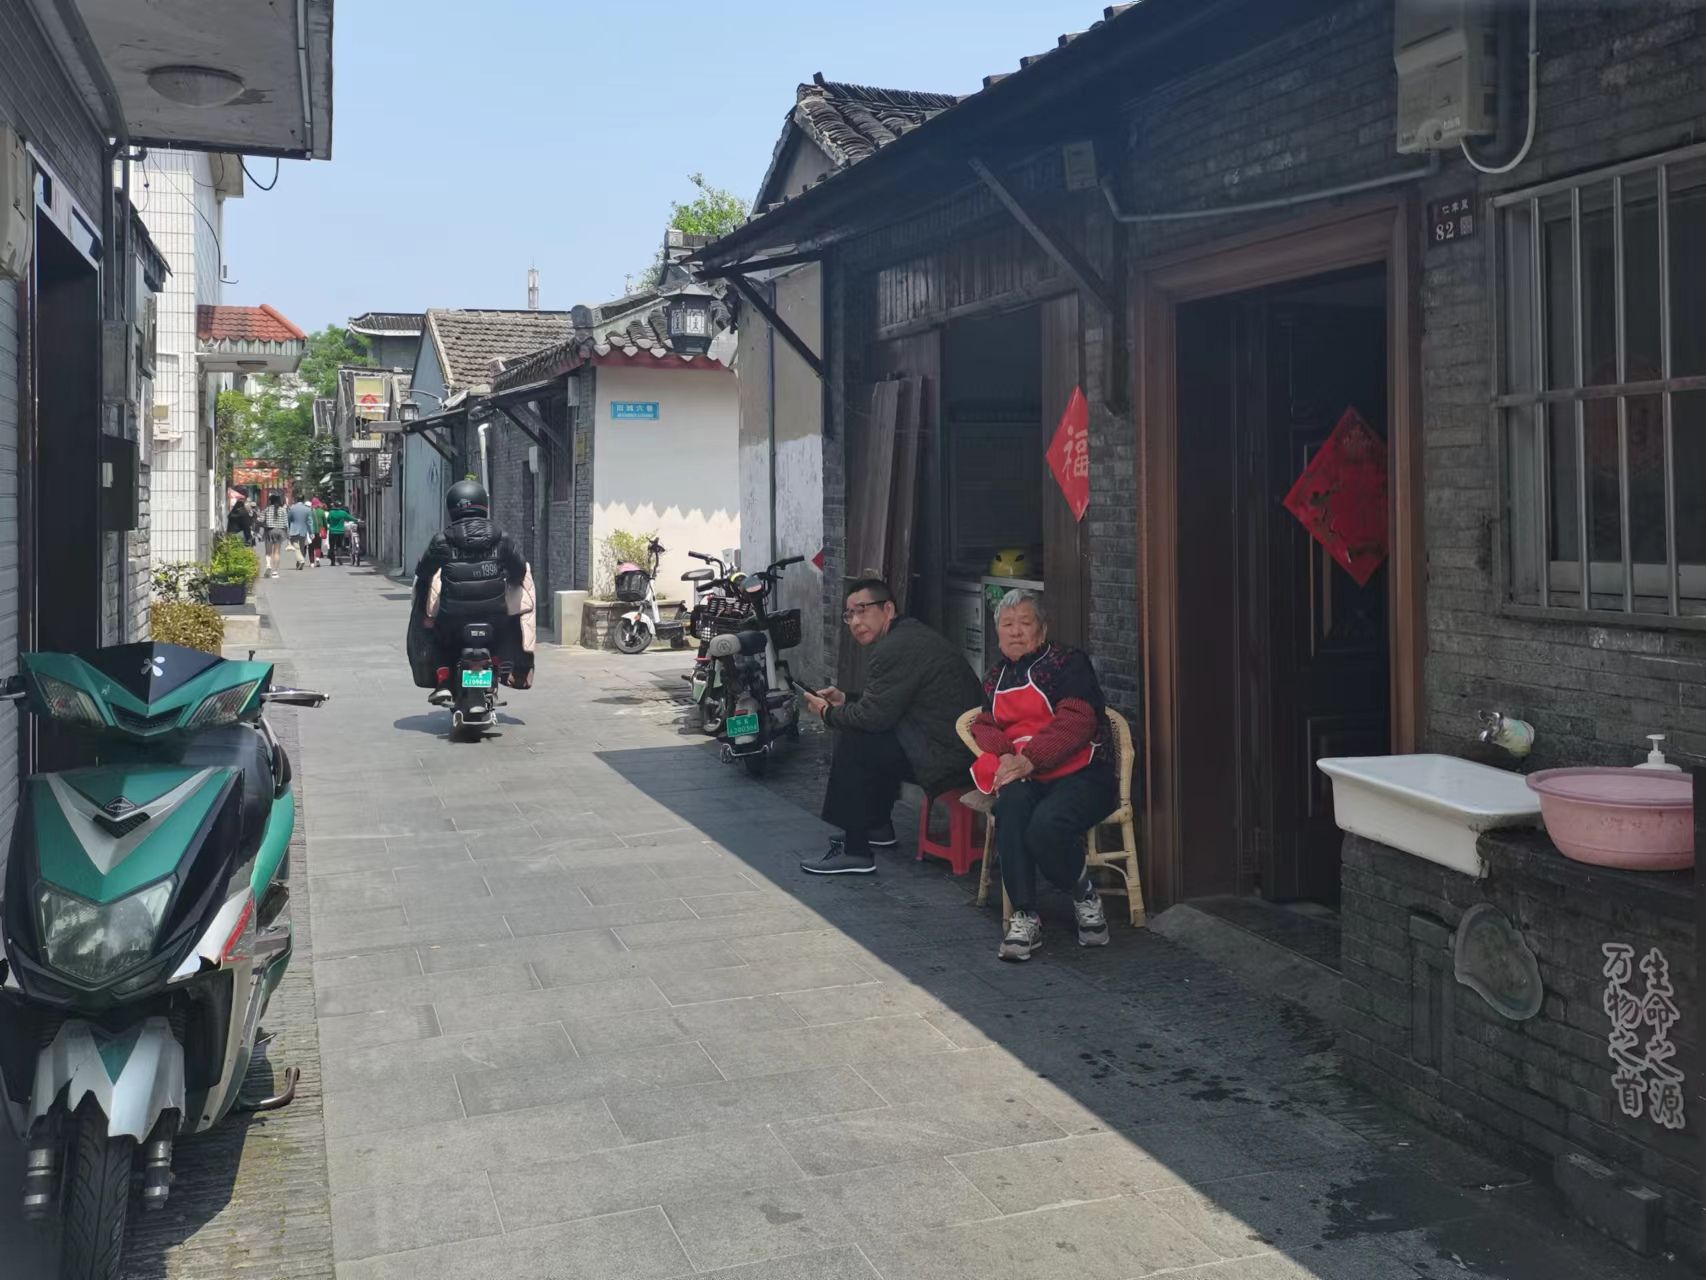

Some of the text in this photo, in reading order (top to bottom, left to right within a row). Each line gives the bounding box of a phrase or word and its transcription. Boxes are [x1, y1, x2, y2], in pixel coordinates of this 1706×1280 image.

[1436, 221, 1454, 241] 82
[1062, 425, 1089, 481] 福
[1602, 943, 1648, 1118] 万物之首
[1639, 947, 1685, 1129] 生命之源
